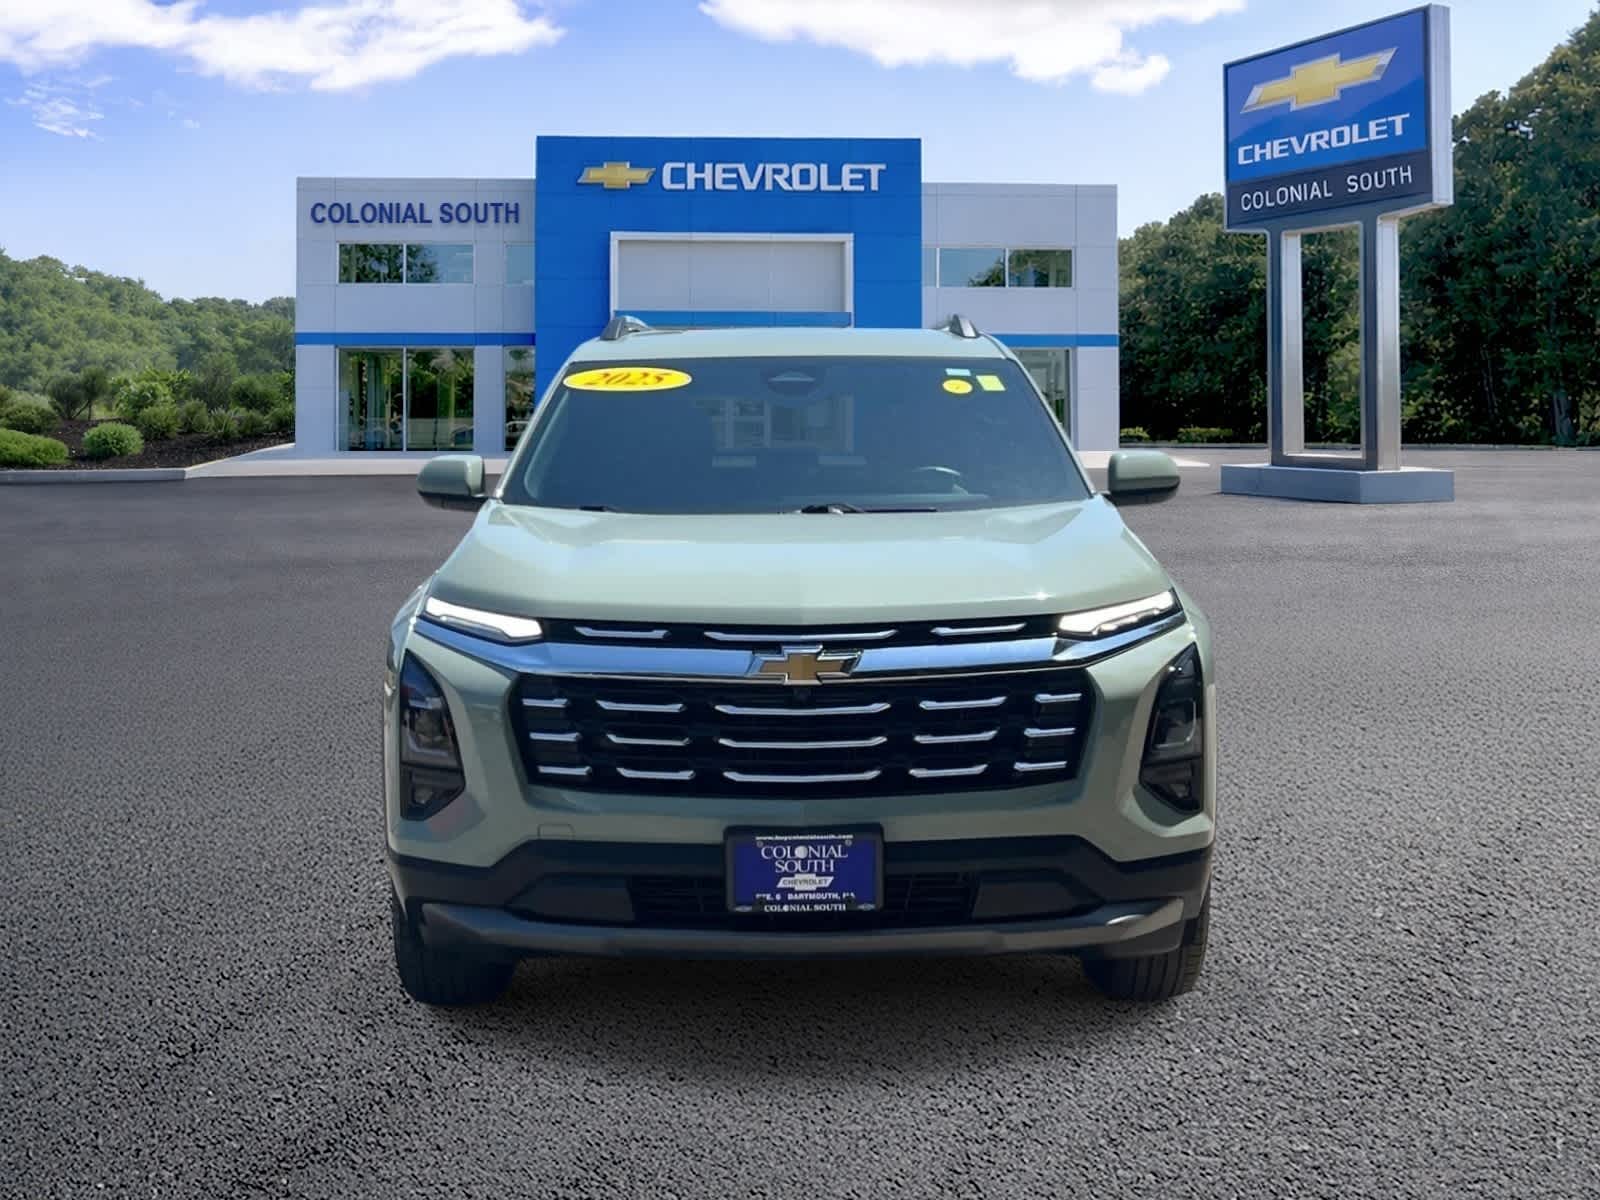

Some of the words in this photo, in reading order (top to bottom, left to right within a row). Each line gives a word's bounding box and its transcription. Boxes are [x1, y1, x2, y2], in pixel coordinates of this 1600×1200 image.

[1238, 113, 1410, 166] CHEVROLET
[661, 161, 887, 193] CHEVROLET
[1240, 180, 1333, 212] COLONIAL
[1346, 165, 1413, 194] SOUTH
[310, 202, 433, 225] COLONIAL
[439, 202, 521, 225] SOUTH
[584, 371, 673, 386] 2025
[761, 844, 849, 860] COLONIAL
[775, 858, 834, 873] SOUTH
[782, 878, 829, 886] CHEVROLET
[764, 904, 813, 913] COLONIAL
[814, 903, 847, 912] SOUTH
